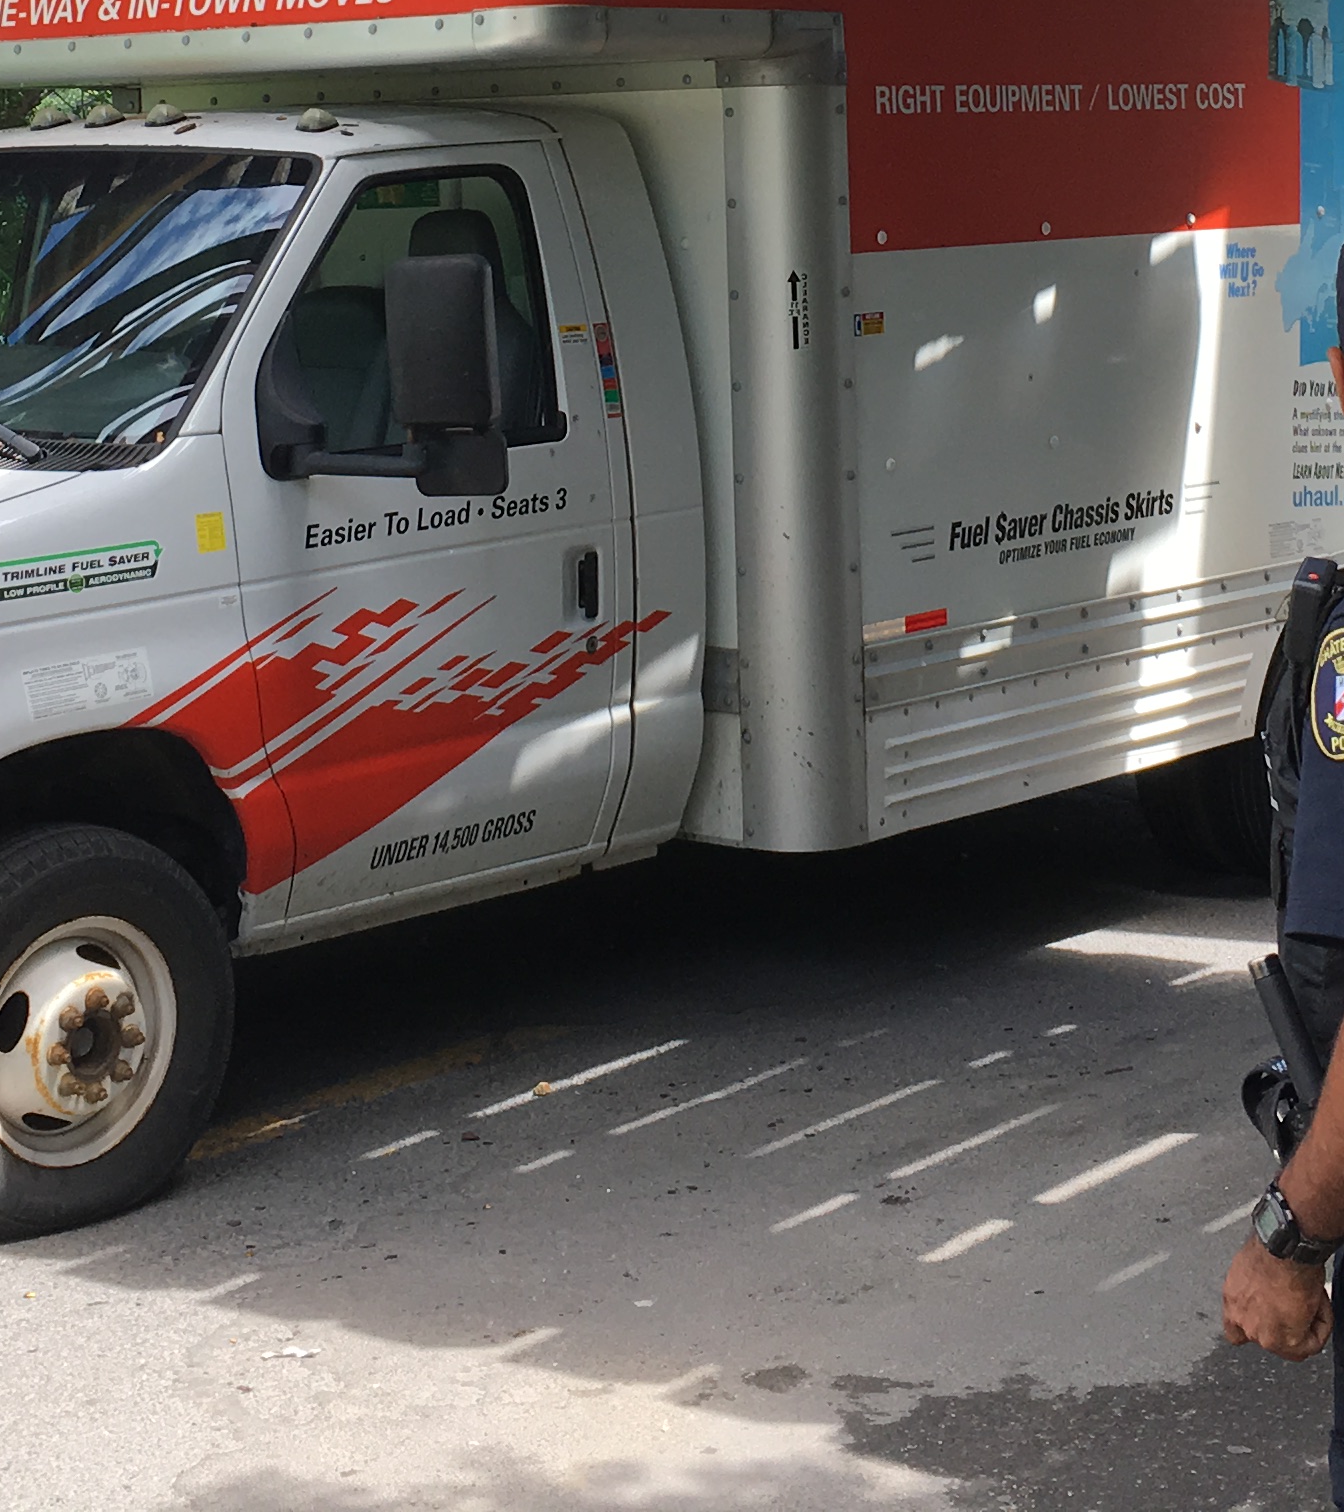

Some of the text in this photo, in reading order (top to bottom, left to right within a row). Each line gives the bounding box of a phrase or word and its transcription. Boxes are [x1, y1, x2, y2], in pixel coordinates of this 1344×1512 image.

[875, 85, 945, 115] RIGHT
[954, 84, 1083, 114] EQUIPMENT
[1107, 83, 1189, 112] LOWEST
[1195, 82, 1246, 110] COST
[1226, 242, 1256, 259] Where
[1219, 260, 1264, 282] Will U Go
[305, 488, 568, 549] Easier To Load Seats 3
[949, 516, 990, 551] Fuel
[1051, 497, 1119, 534] Chassis
[1124, 489, 1174, 521] Skirts
[999, 527, 1136, 565] OPTIMIZE YOUR FUEL ECONOMY
[2, 564, 66, 582] TRIMLINE
[72, 559, 104, 572] FUEL
[3, 589, 24, 598] LOW
[27, 582, 65, 595] PROFILE
[88, 568, 152, 586] AERODYNAMIC
[370, 809, 536, 870] UNDER 14,500 GROSS
